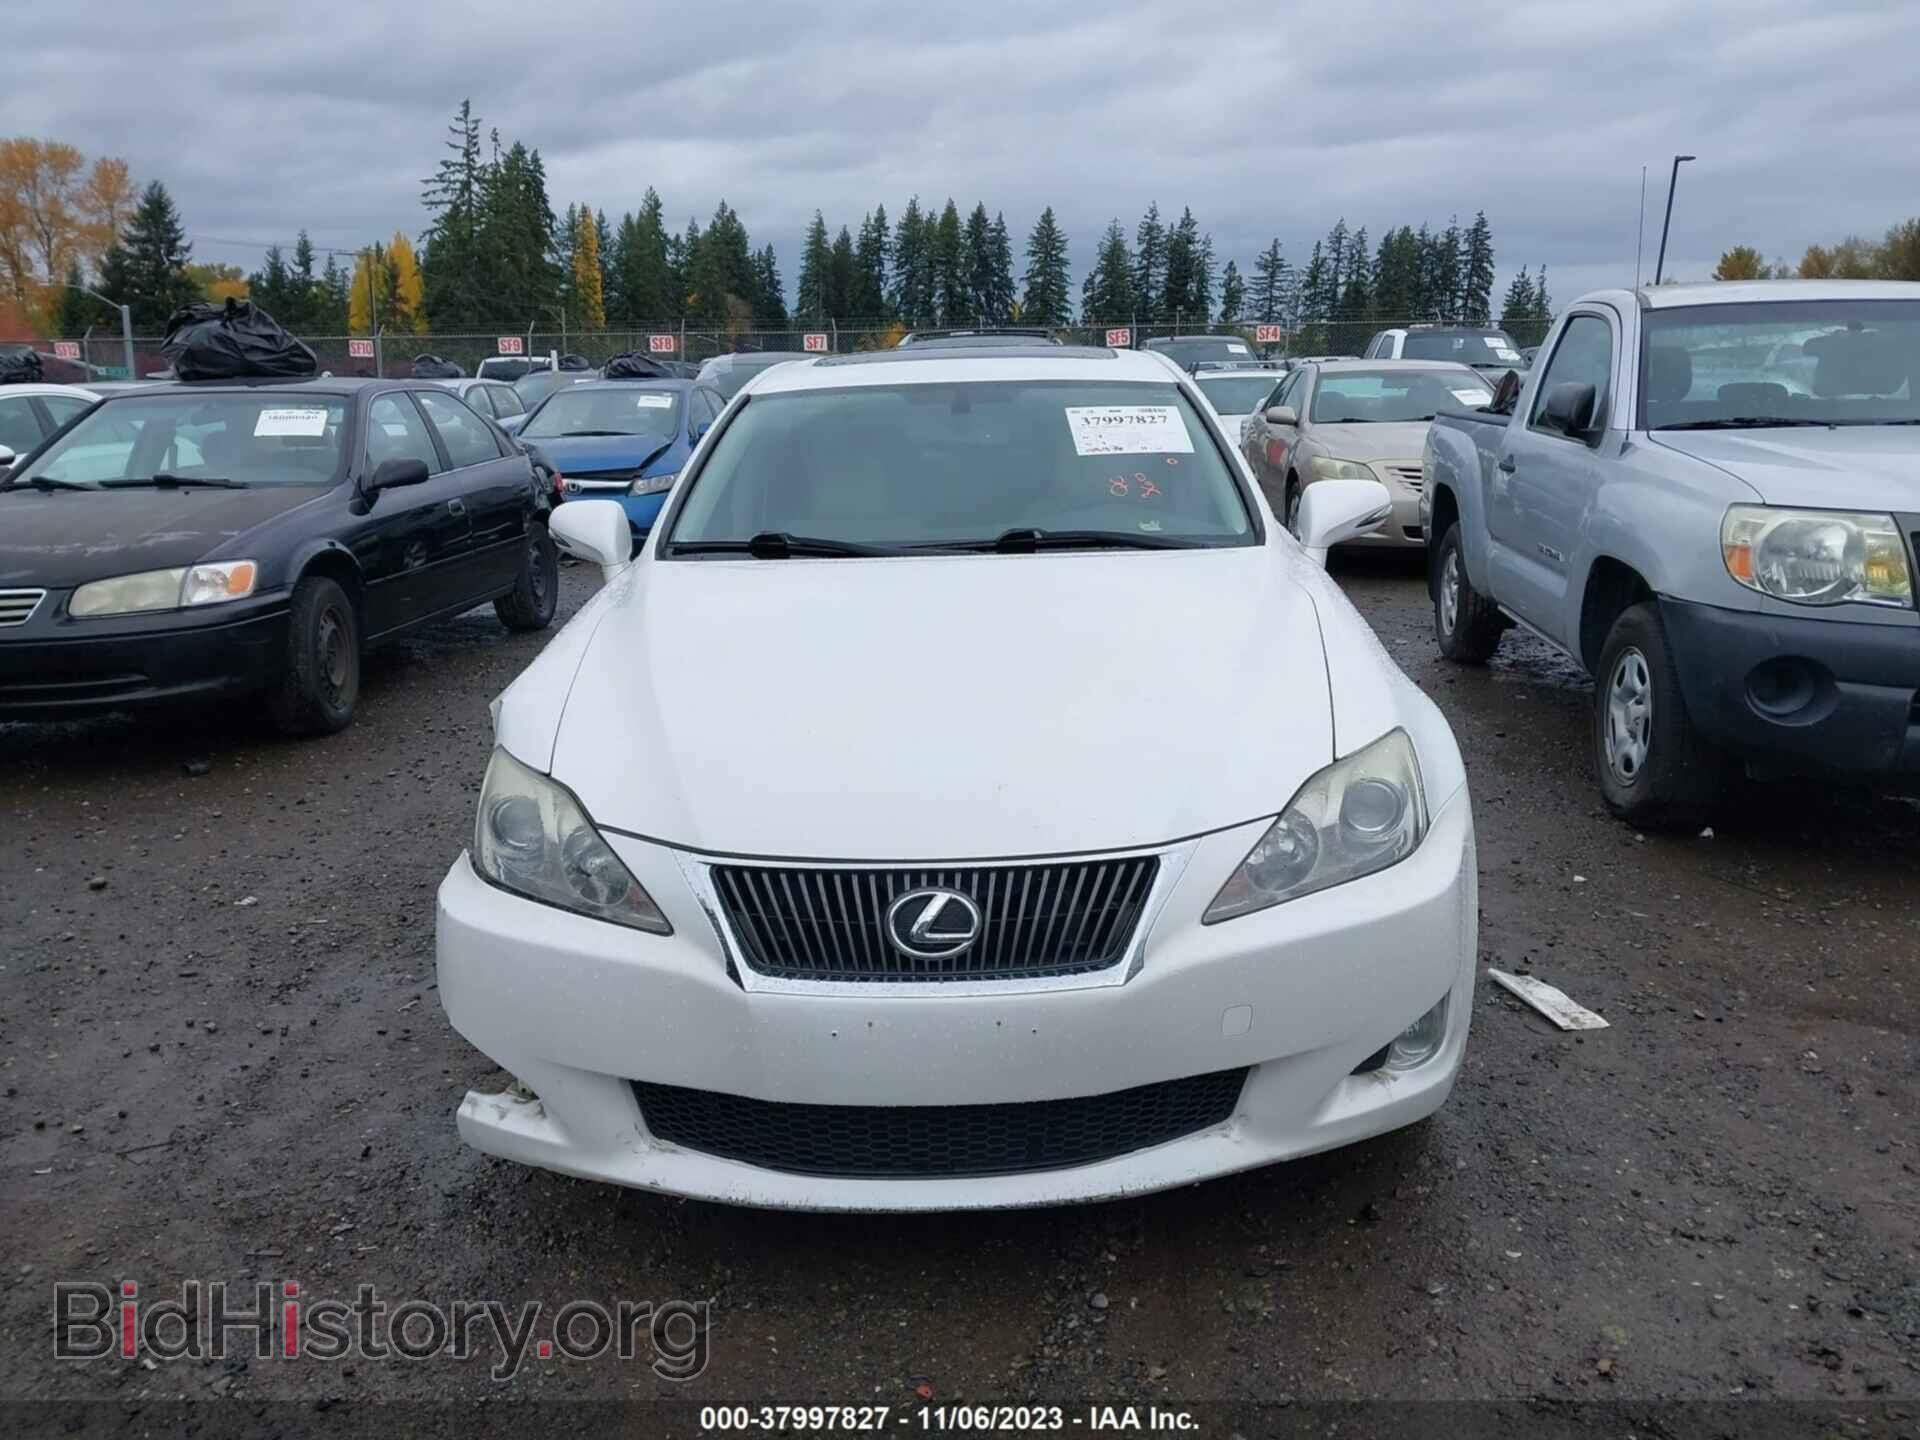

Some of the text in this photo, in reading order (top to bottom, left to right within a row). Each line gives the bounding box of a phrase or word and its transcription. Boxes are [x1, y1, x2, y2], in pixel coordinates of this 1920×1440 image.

[1108, 330, 1129, 345] SF5
[1258, 326, 1279, 340] SF4
[350, 341, 373, 355] SF10
[651, 336, 672, 350] SF8
[806, 335, 825, 349] SF7
[1081, 415, 1167, 425] 37997827
